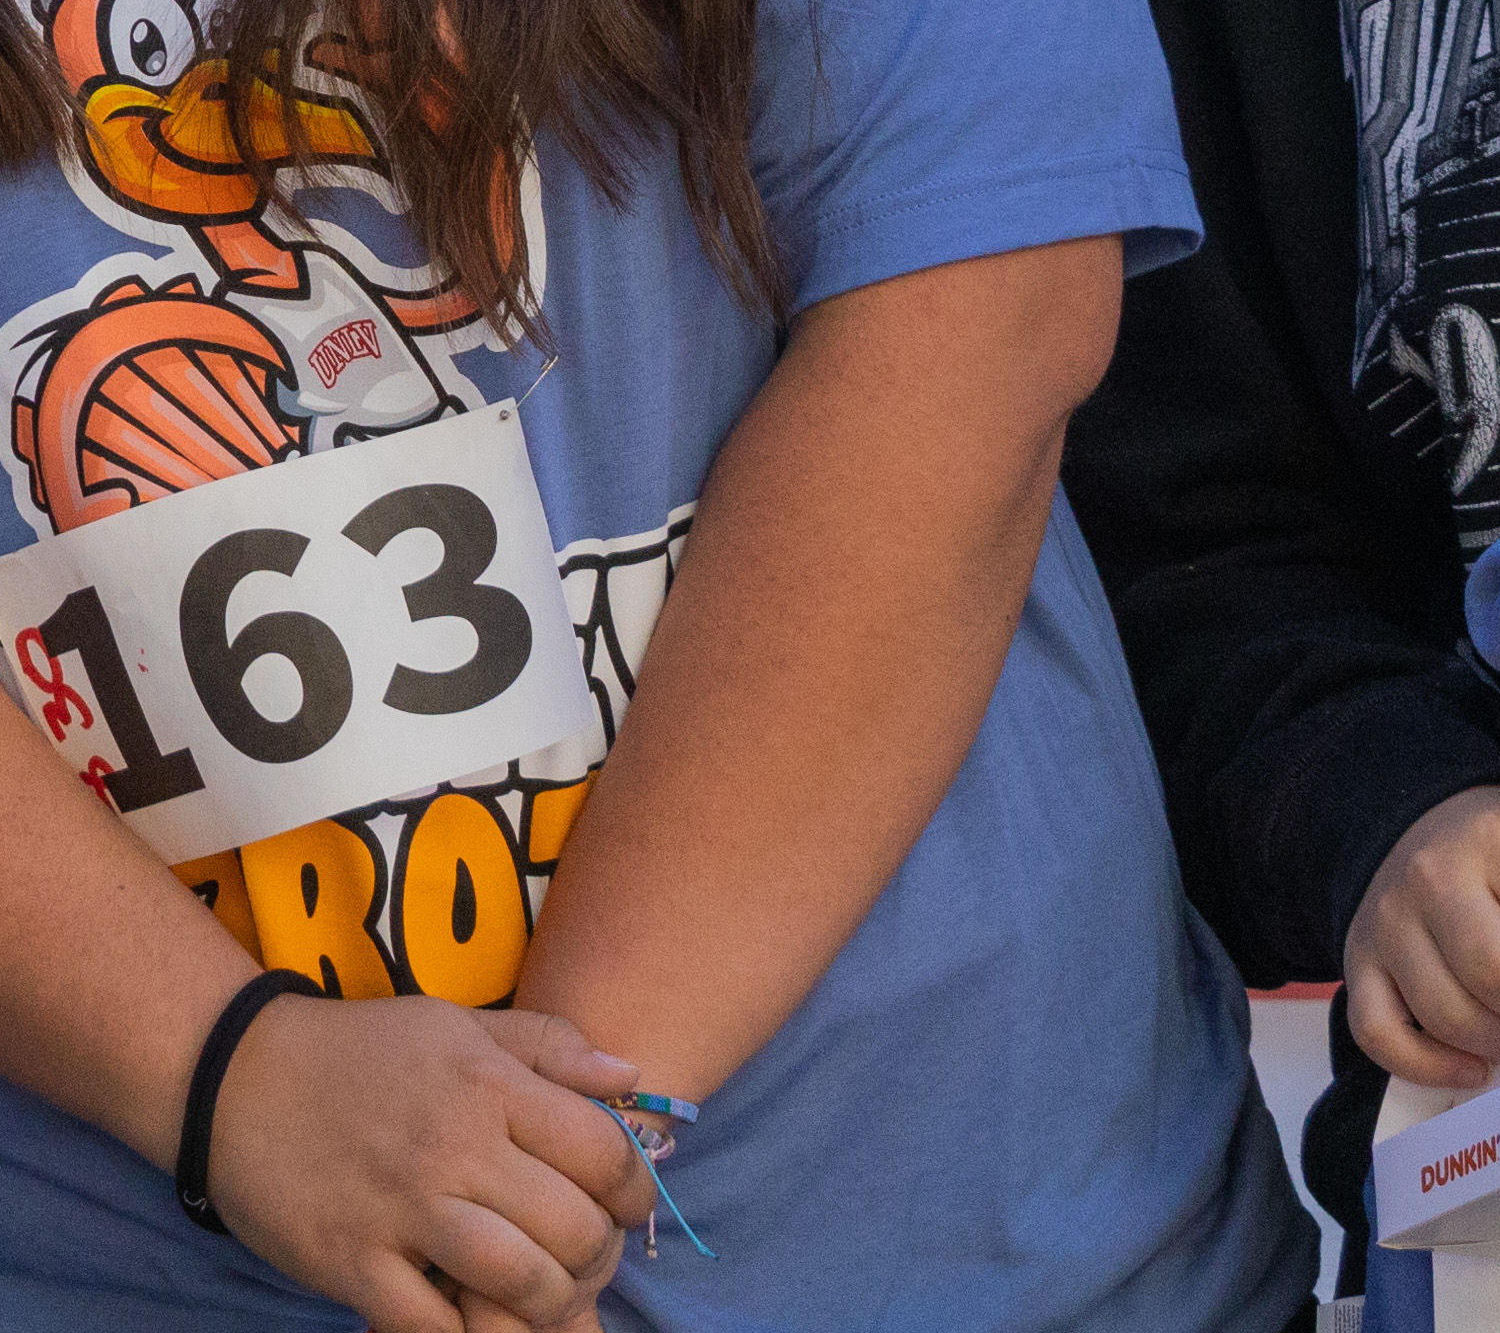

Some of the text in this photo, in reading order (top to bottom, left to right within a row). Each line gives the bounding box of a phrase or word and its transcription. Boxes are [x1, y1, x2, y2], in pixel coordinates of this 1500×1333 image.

[307, 318, 382, 390] UNLV
[40, 482, 533, 815] 163
[165, 758, 602, 1010] RO
[1420, 1133, 1500, 1194] DUNKIN'
